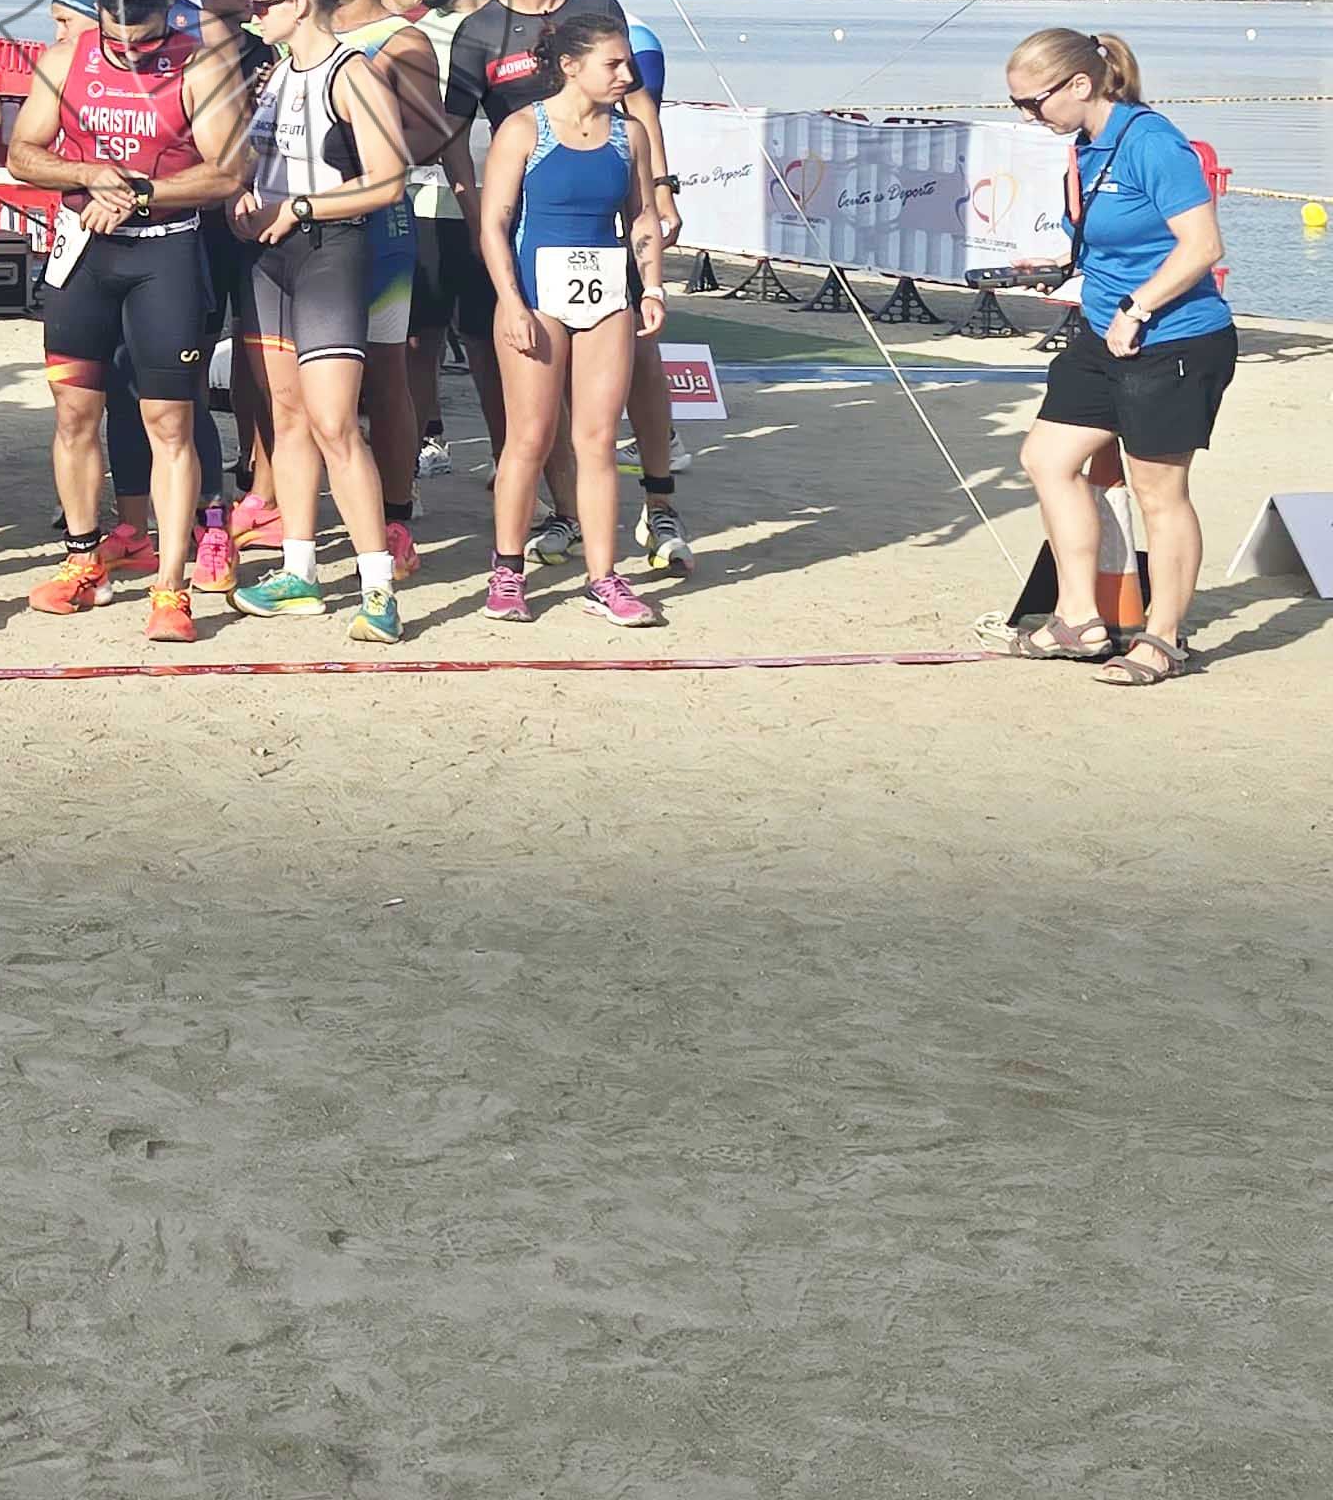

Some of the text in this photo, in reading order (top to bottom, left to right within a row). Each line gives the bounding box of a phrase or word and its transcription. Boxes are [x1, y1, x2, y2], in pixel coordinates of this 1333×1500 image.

[79, 105, 158, 138] CHRISTIAN
[95, 135, 141, 162] ESP
[53, 235, 66, 259] 8
[567, 278, 603, 304] 26
